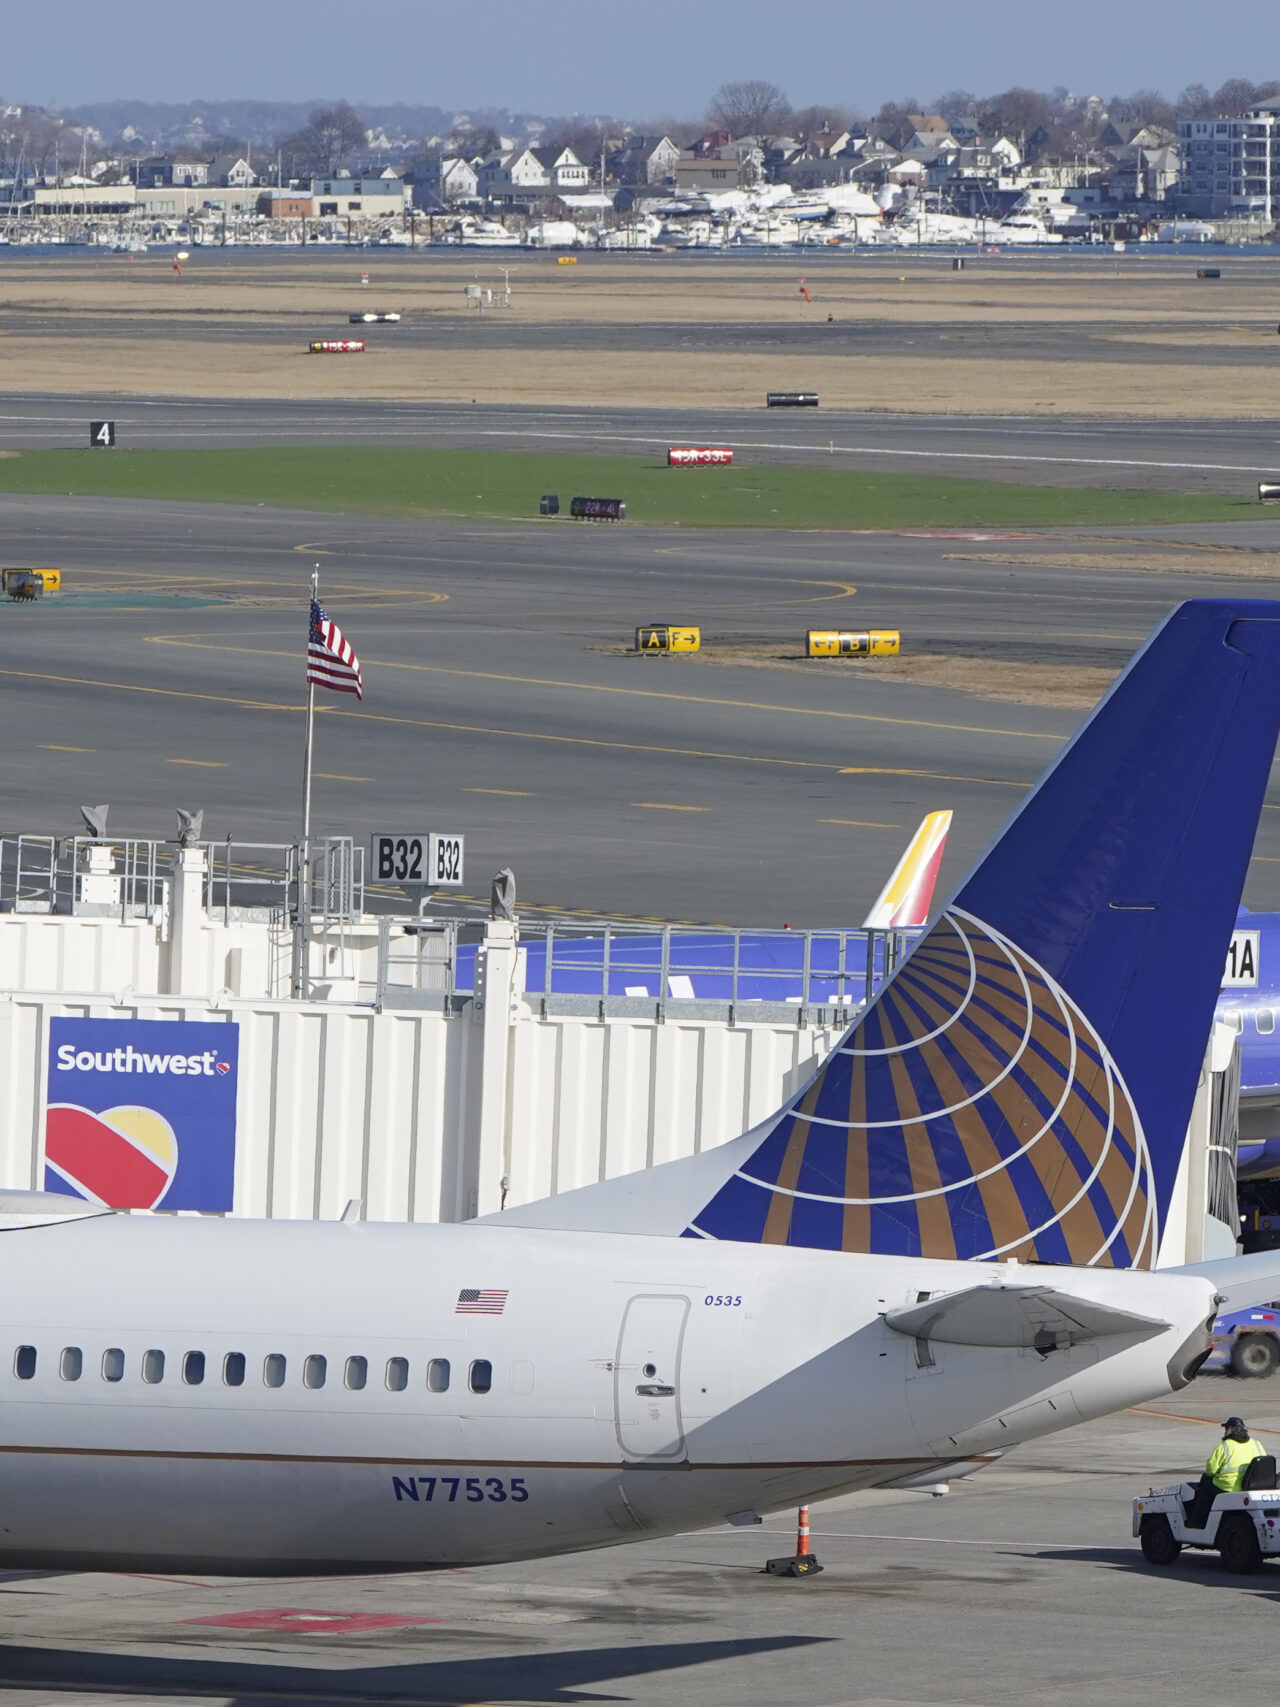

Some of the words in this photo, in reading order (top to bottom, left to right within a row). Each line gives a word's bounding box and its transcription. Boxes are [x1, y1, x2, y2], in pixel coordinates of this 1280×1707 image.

[96, 422, 110, 445] 4
[647, 631, 660, 648] A
[672, 631, 681, 647] F
[828, 635, 836, 650] F
[849, 634, 860, 651] B
[872, 634, 881, 649] F
[379, 838, 422, 880] B32
[437, 839, 460, 880] B32
[1229, 939, 1254, 978] 1A
[56, 1044, 215, 1076] Southwest
[704, 1295, 742, 1307] 0535
[392, 1476, 529, 1503] N77535
